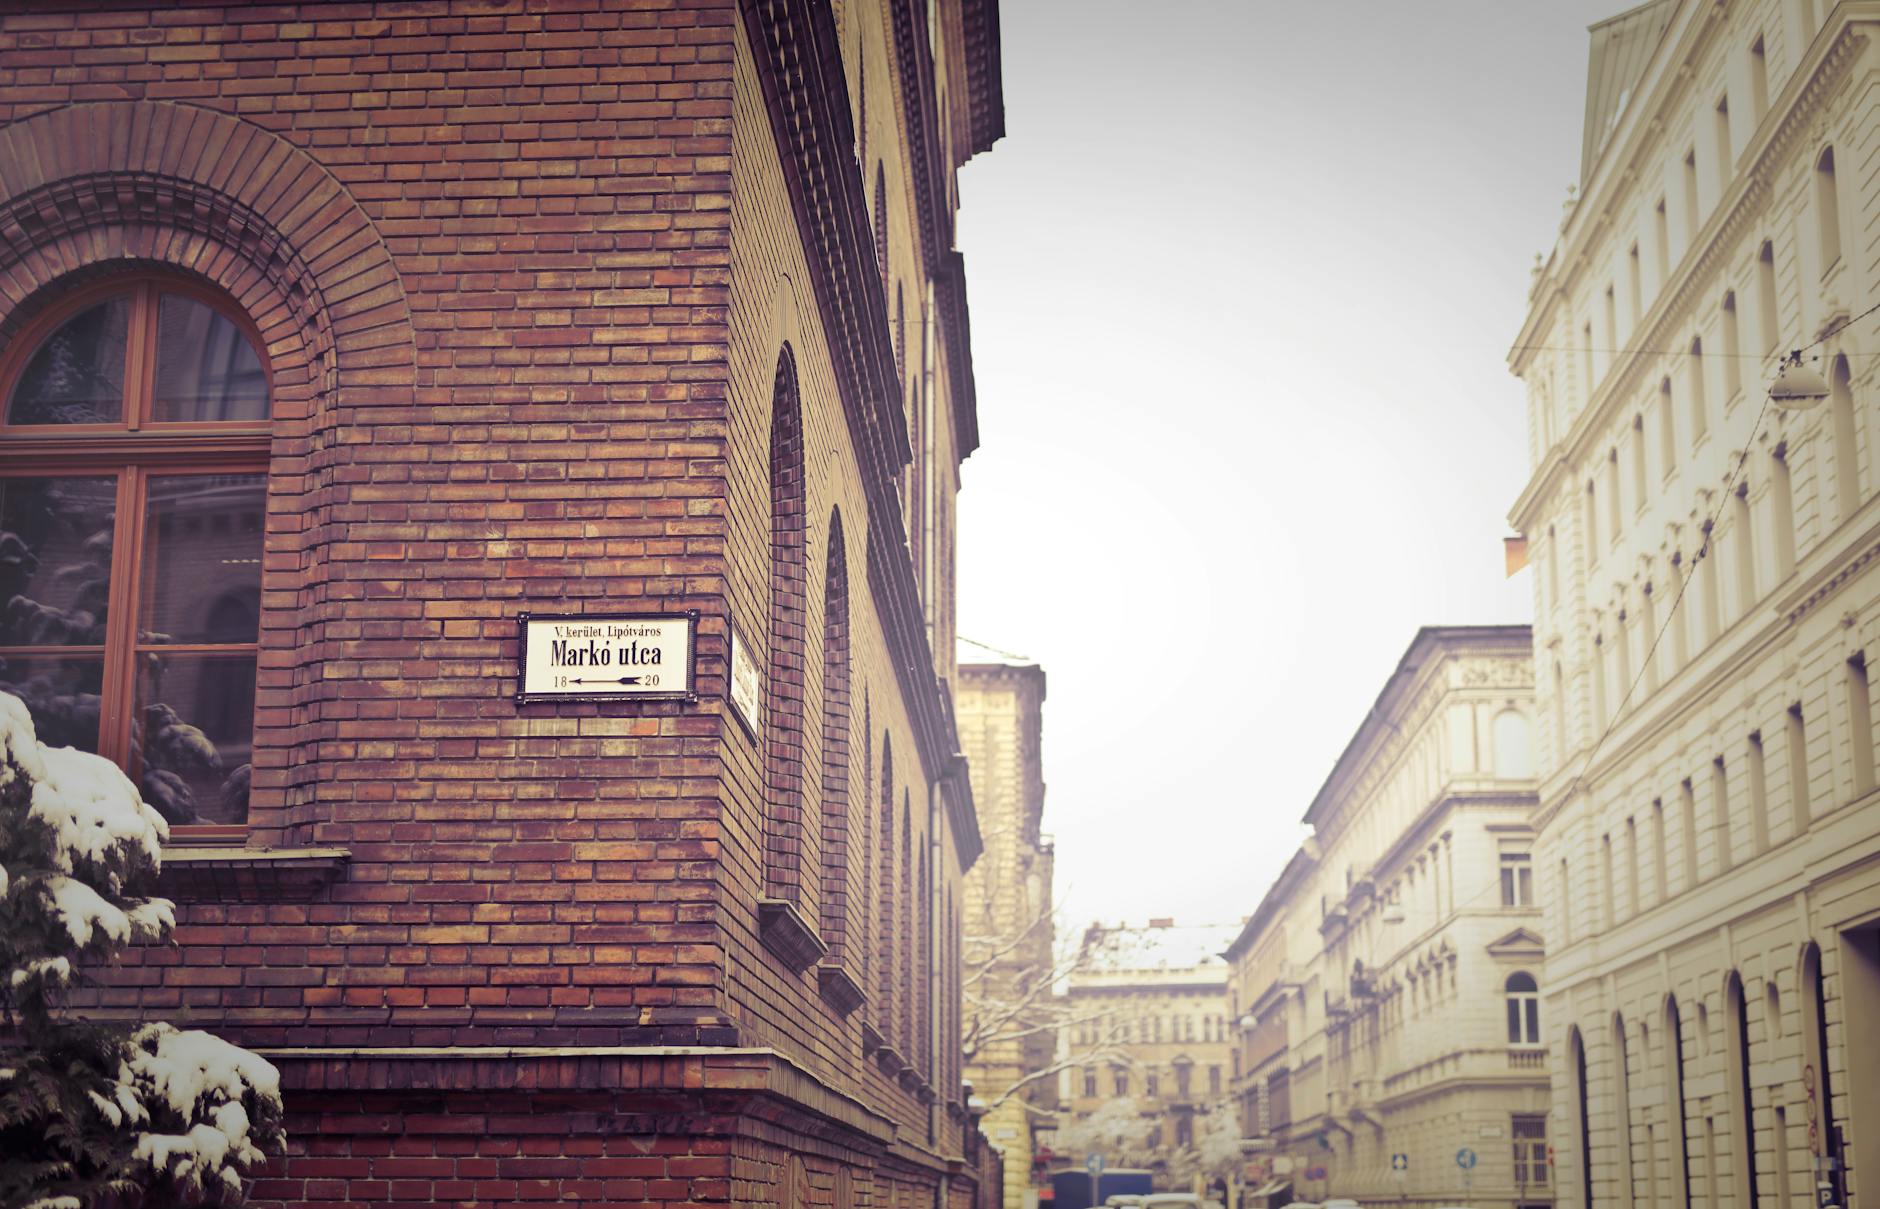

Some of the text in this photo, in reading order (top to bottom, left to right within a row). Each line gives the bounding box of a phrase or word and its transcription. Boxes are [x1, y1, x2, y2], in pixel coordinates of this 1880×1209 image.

[554, 624, 662, 639] V. kerület, Lipótváros
[551, 639, 662, 667] Markó utca
[554, 675, 660, 688] 18 20
[1821, 1190, 1832, 1204] P
